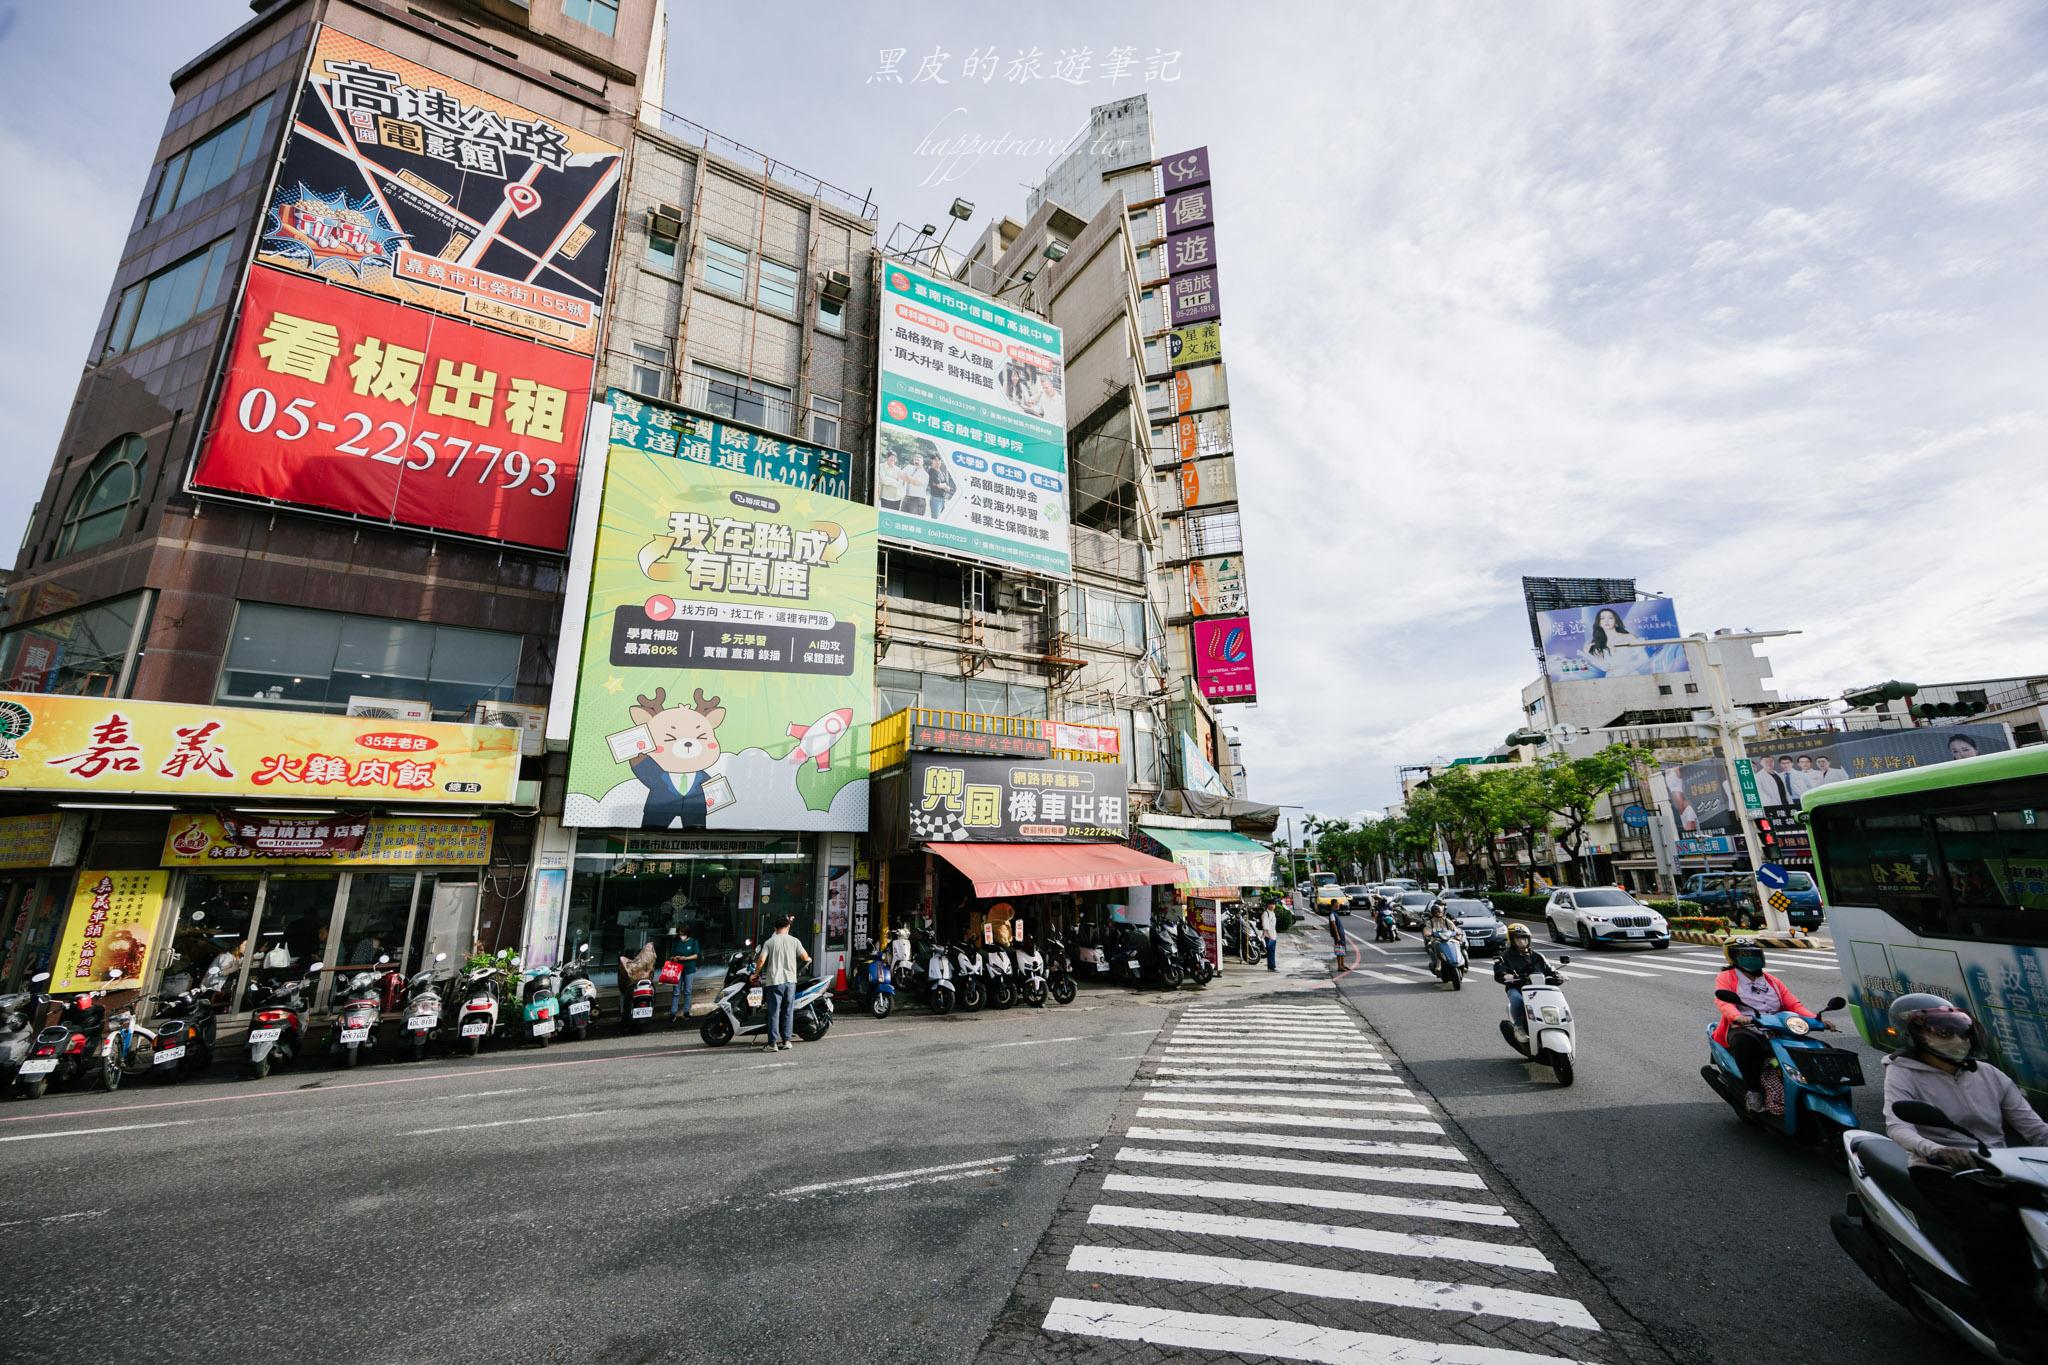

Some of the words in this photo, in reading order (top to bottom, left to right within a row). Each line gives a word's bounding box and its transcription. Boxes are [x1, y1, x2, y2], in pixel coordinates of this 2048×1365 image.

[325, 60, 571, 171] 高速公路
[348, 109, 378, 144] 包廂
[379, 115, 504, 177] 電影館
[565, 229, 589, 254] 中山路
[403, 257, 585, 318] 嘉義市北榮街155號
[1175, 274, 1212, 296] 商旅
[1184, 295, 1206, 307] 11F
[473, 299, 566, 335] 快來看電影！
[895, 326, 944, 353] 品格教育
[947, 345, 995, 371] 全人發展
[257, 311, 568, 444] 看板出租
[894, 345, 944, 372] 頂大升學
[947, 364, 995, 390] 醫科搖籃
[238, 387, 558, 497] 05-2257793
[610, 417, 747, 474] 寶達通運
[912, 411, 1025, 454] 中信金融管理學院
[970, 476, 1039, 503] 高額獎助學金
[970, 494, 1039, 521] 公費海外學習
[667, 511, 829, 566] 我在聯成
[970, 512, 1050, 541] 畢業生保障就業
[685, 551, 810, 600] 有頭鹿
[681, 604, 829, 627] 找方向、找工作，這裡有門路
[624, 642, 678, 656] 最高80%
[703, 646, 728, 660] 實體
[731, 647, 754, 660] 直播
[758, 648, 781, 661] 錄播
[803, 652, 845, 665] 保證面試
[626, 628, 679, 641] 學費補助
[720, 633, 767, 647] 多元學習
[808, 639, 841, 652] AI助攻
[48, 714, 234, 778] 嘉義
[252, 754, 436, 790] 火雞肉飯
[364, 735, 428, 751] 35年老店
[448, 782, 478, 793] 總店
[1012, 770, 1093, 789] 網路評鑑第一
[1740, 767, 1757, 802] 中山路
[921, 766, 1003, 829] 兜風
[1008, 792, 1122, 825] 機車出租
[1068, 826, 1122, 837] 05-2272345
[91, 875, 114, 938] 嘉義車頭
[854, 883, 870, 950] 機車出租
